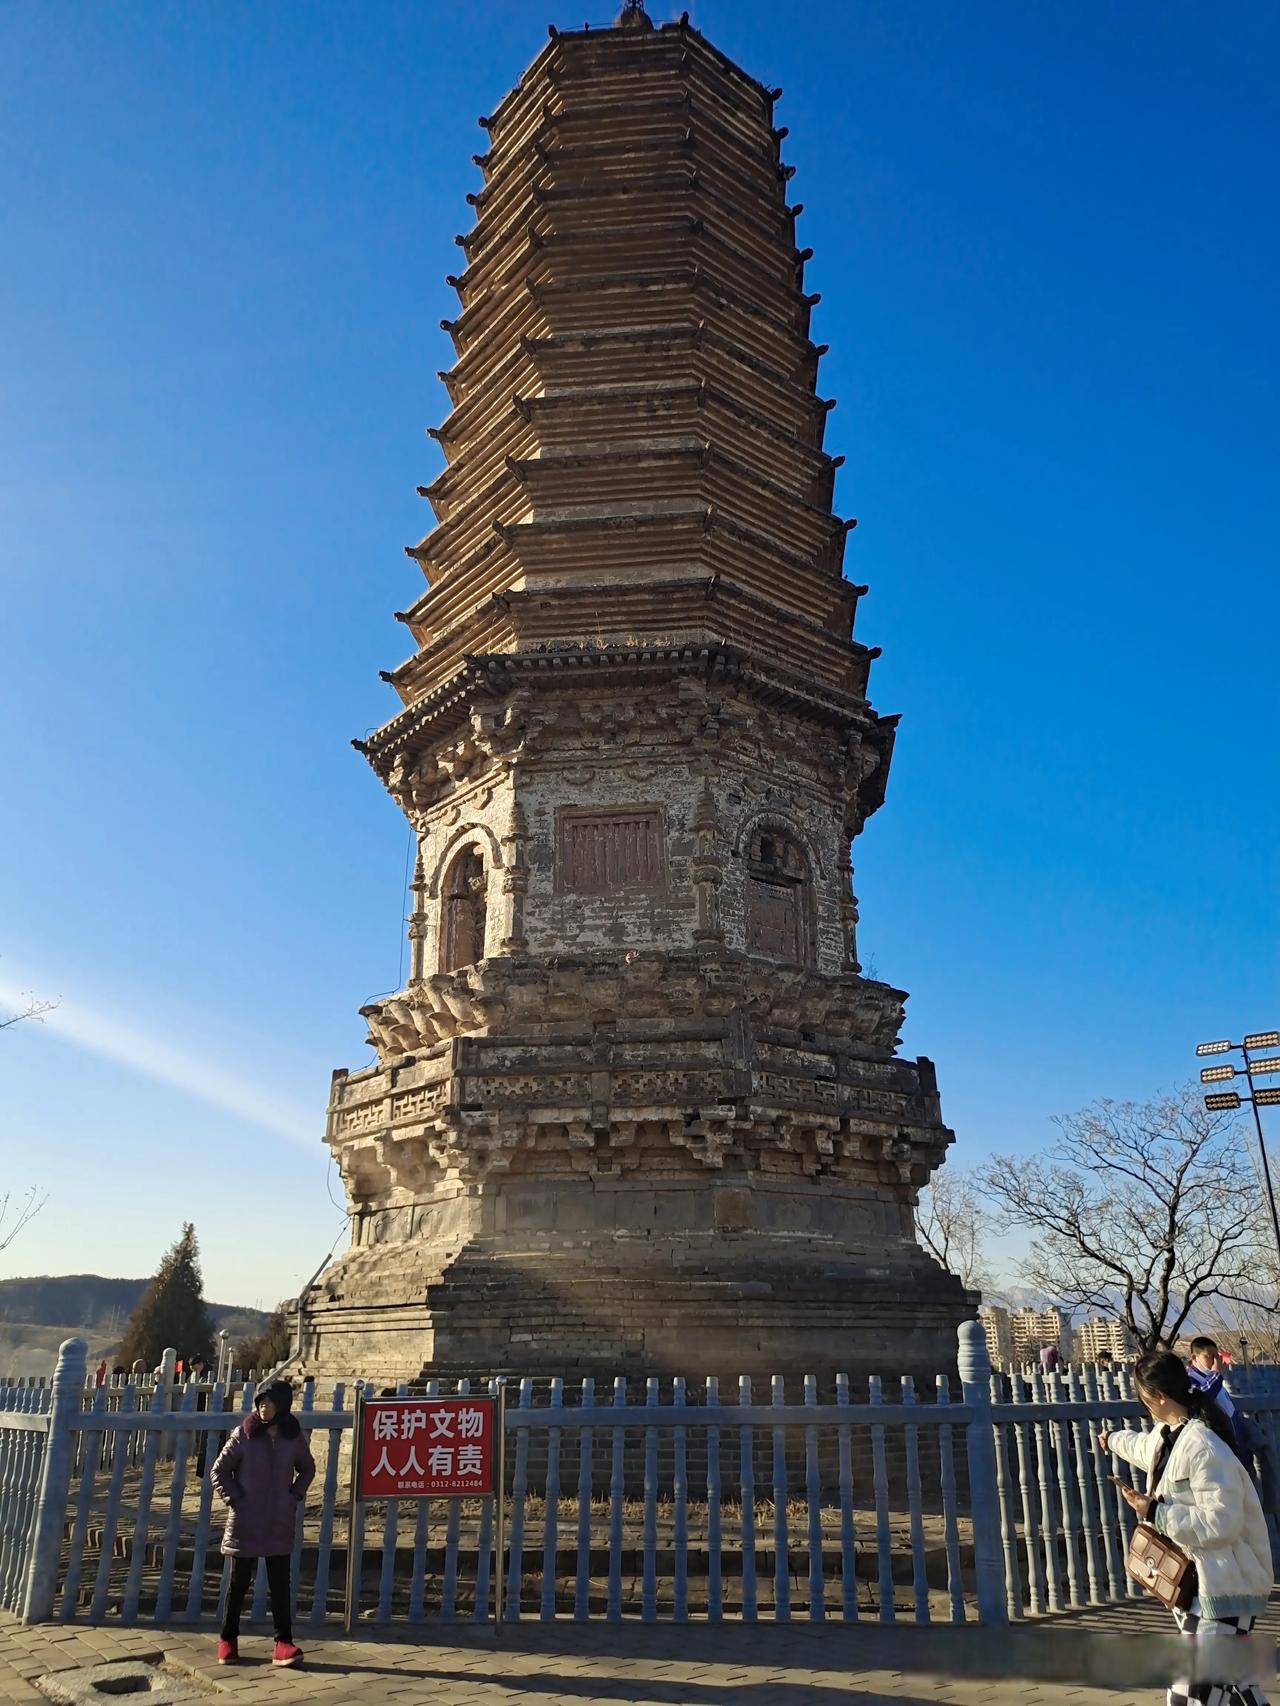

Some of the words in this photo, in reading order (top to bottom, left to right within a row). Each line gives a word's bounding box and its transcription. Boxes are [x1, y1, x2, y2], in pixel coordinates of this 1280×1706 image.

[372, 1407, 484, 1440] 保护文物
[370, 1444, 483, 1477] 人人有责
